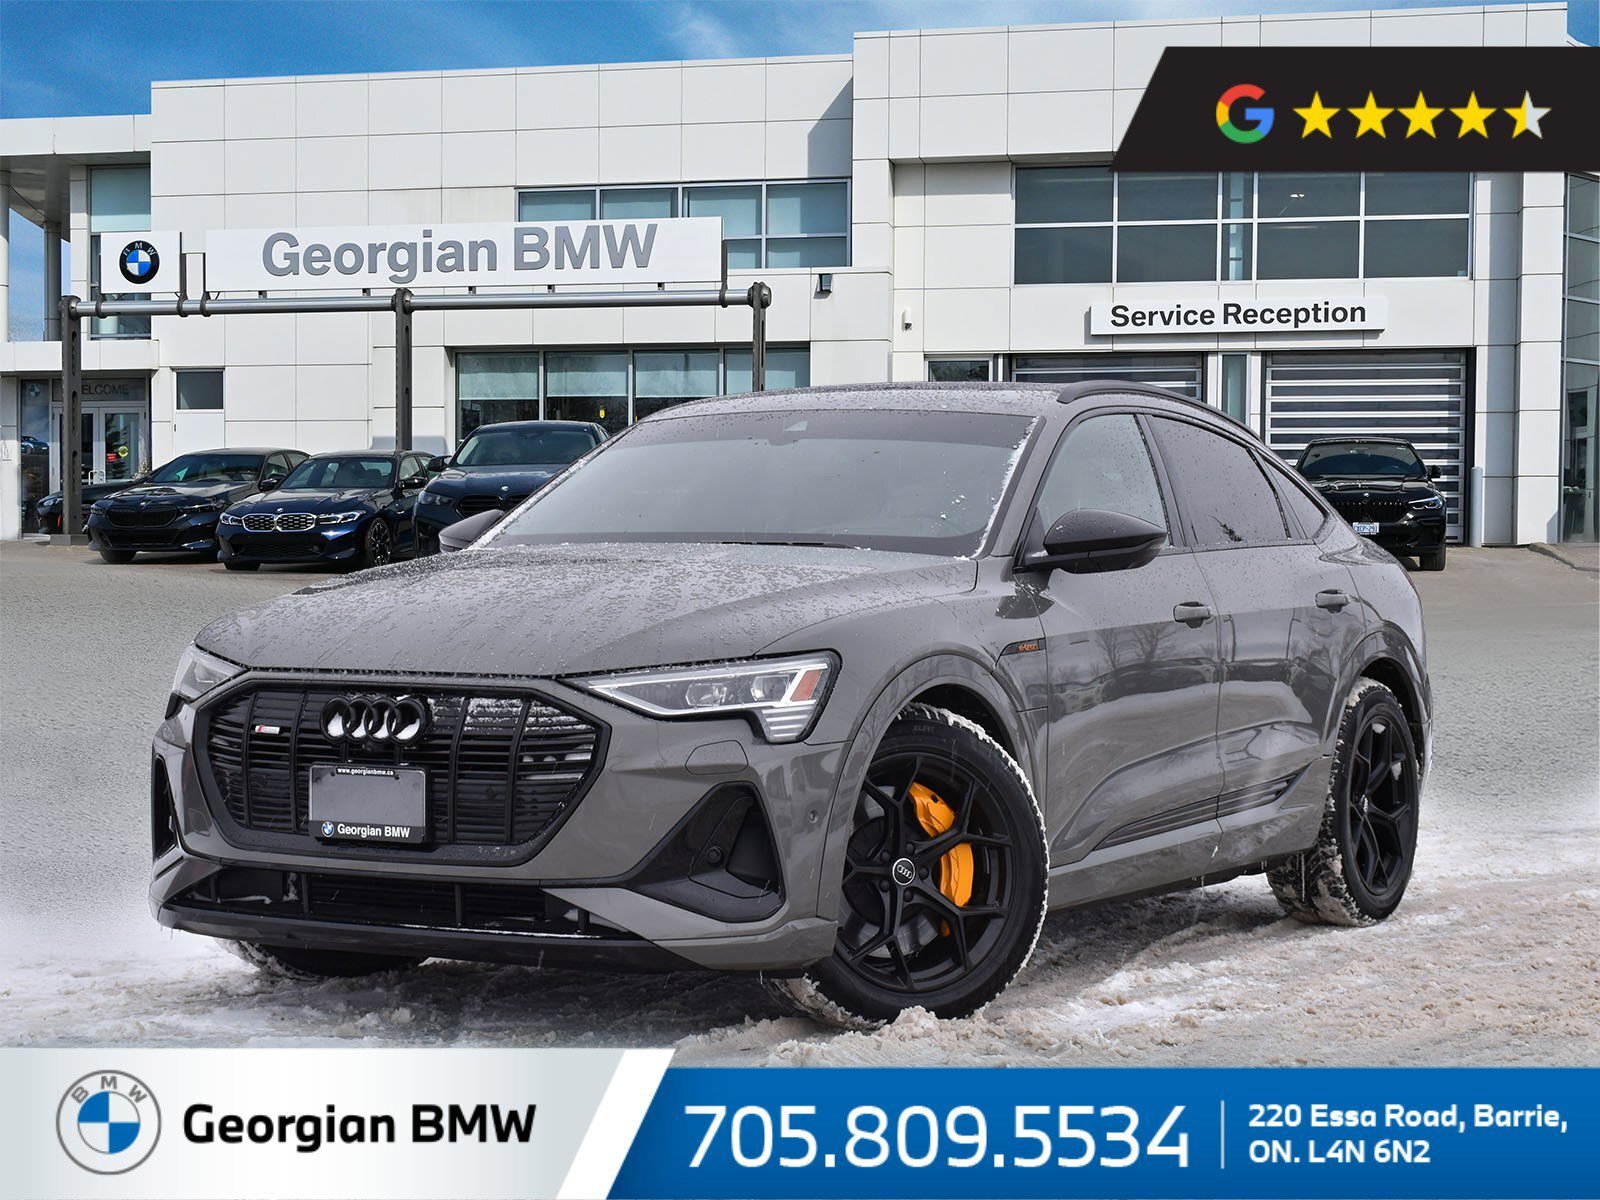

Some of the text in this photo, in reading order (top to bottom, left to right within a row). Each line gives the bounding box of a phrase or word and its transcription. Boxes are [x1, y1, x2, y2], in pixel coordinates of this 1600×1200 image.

[262, 223, 659, 284] Georgian BMW
[1110, 300, 1367, 329] Service Reception
[81, 383, 129, 395] ELCOME
[337, 823, 411, 839] Georgian BMW
